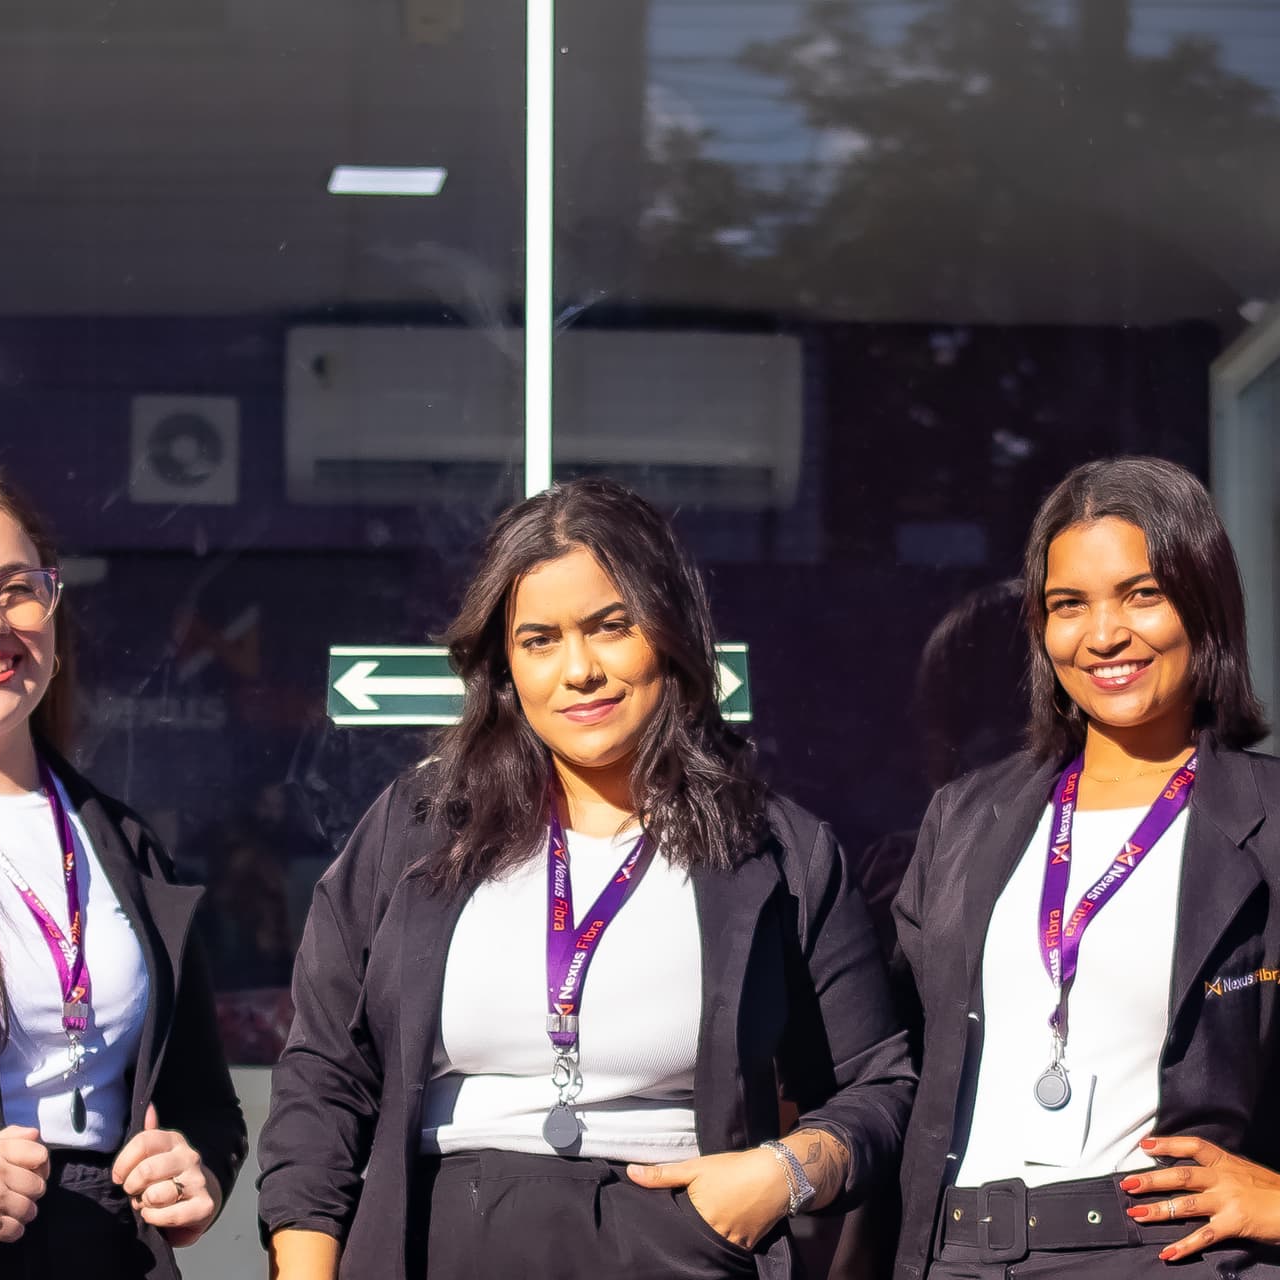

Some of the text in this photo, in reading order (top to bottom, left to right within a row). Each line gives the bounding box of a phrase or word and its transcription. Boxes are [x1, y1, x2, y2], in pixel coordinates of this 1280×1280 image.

[1055, 772, 1078, 844] Nexus Fibra
[1163, 769, 1195, 800] Fibra
[553, 859, 569, 931] Nexus Fibra
[1045, 909, 1061, 947] Fibra
[1064, 864, 1127, 937] Nexus Fibra
[558, 919, 605, 1000] Nexus Fibra
[1223, 974, 1254, 993] Nexus
